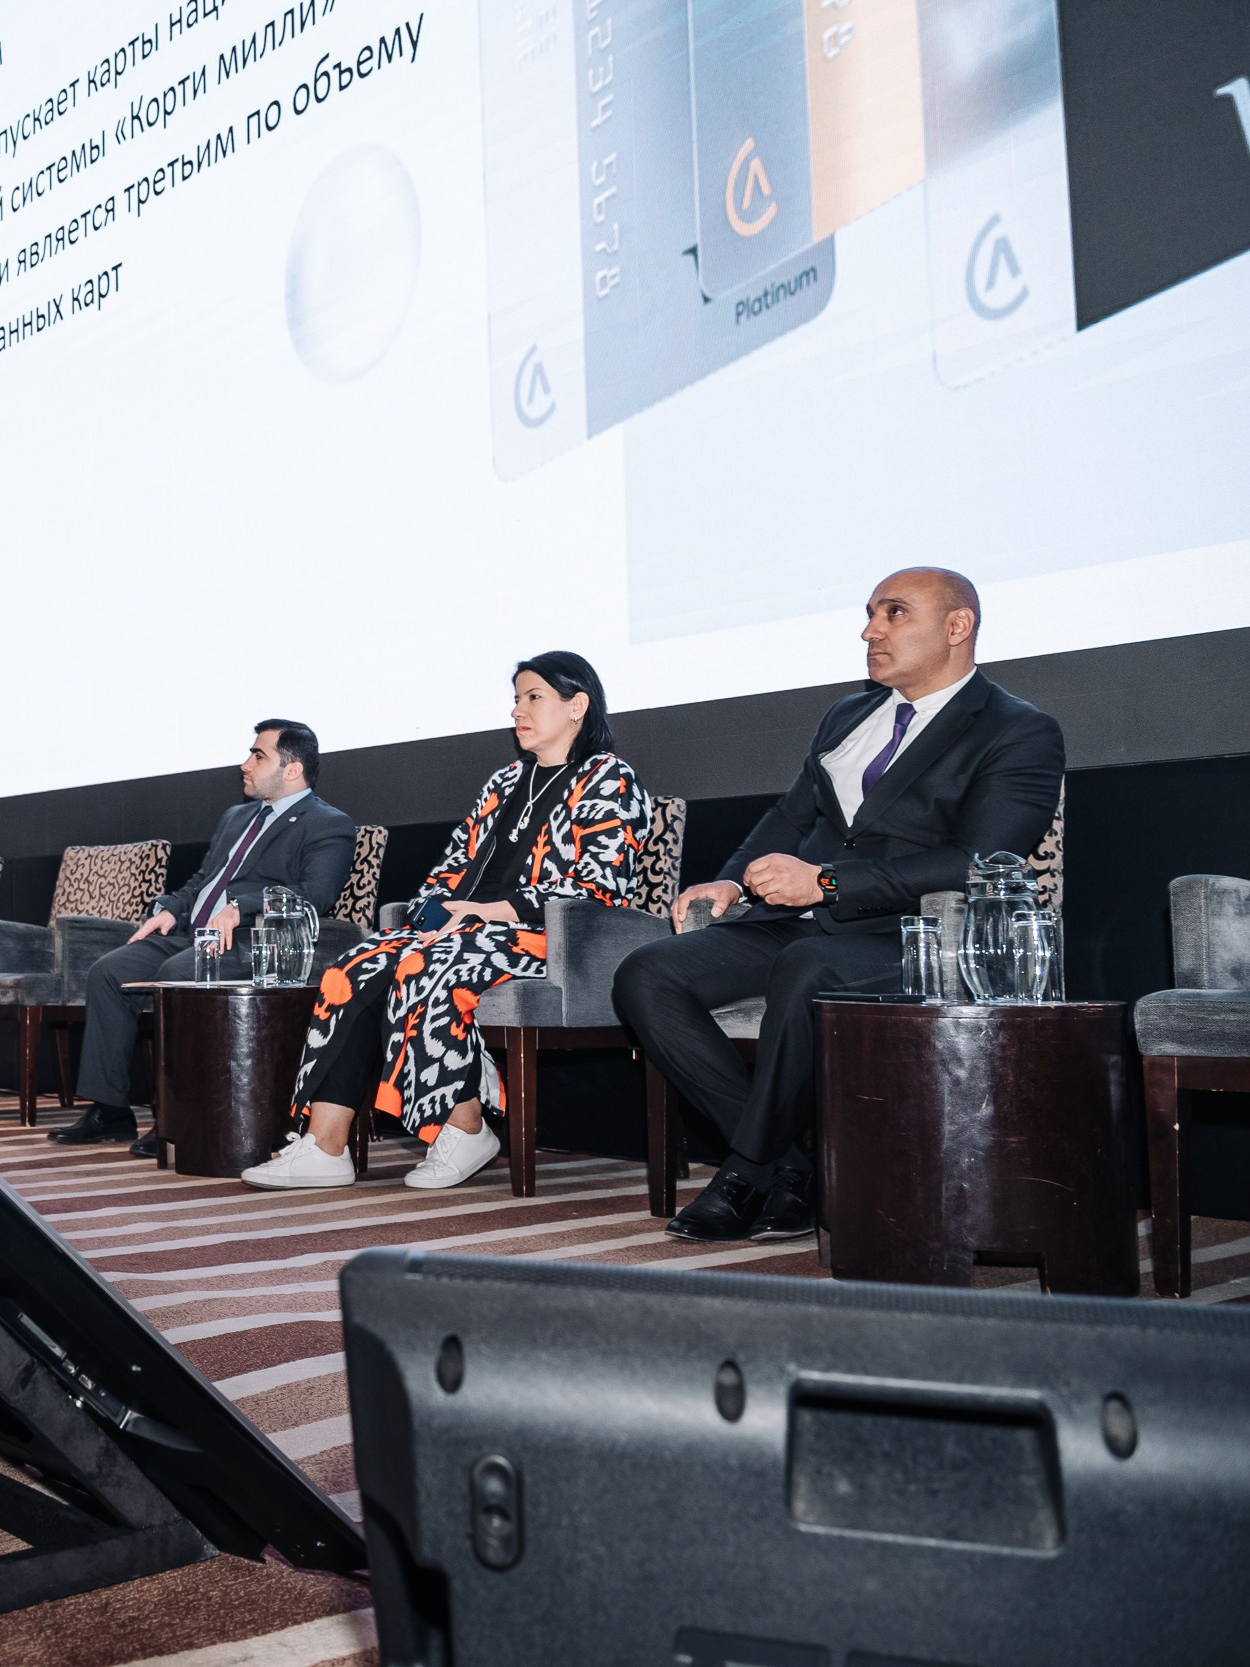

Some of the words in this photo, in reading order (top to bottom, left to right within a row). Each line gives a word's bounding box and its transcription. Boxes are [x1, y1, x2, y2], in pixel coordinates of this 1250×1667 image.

[87, 23, 159, 98] карты
[169, 0, 226, 42] нац
[10, 129, 106, 213] системы
[114, 65, 207, 145] «Корти
[16, 195, 116, 277] является
[123, 126, 236, 218] третьим
[246, 99, 282, 145] по
[292, 12, 425, 116] объему
[71, 262, 123, 315] карт
[735, 265, 819, 326] Platinum
